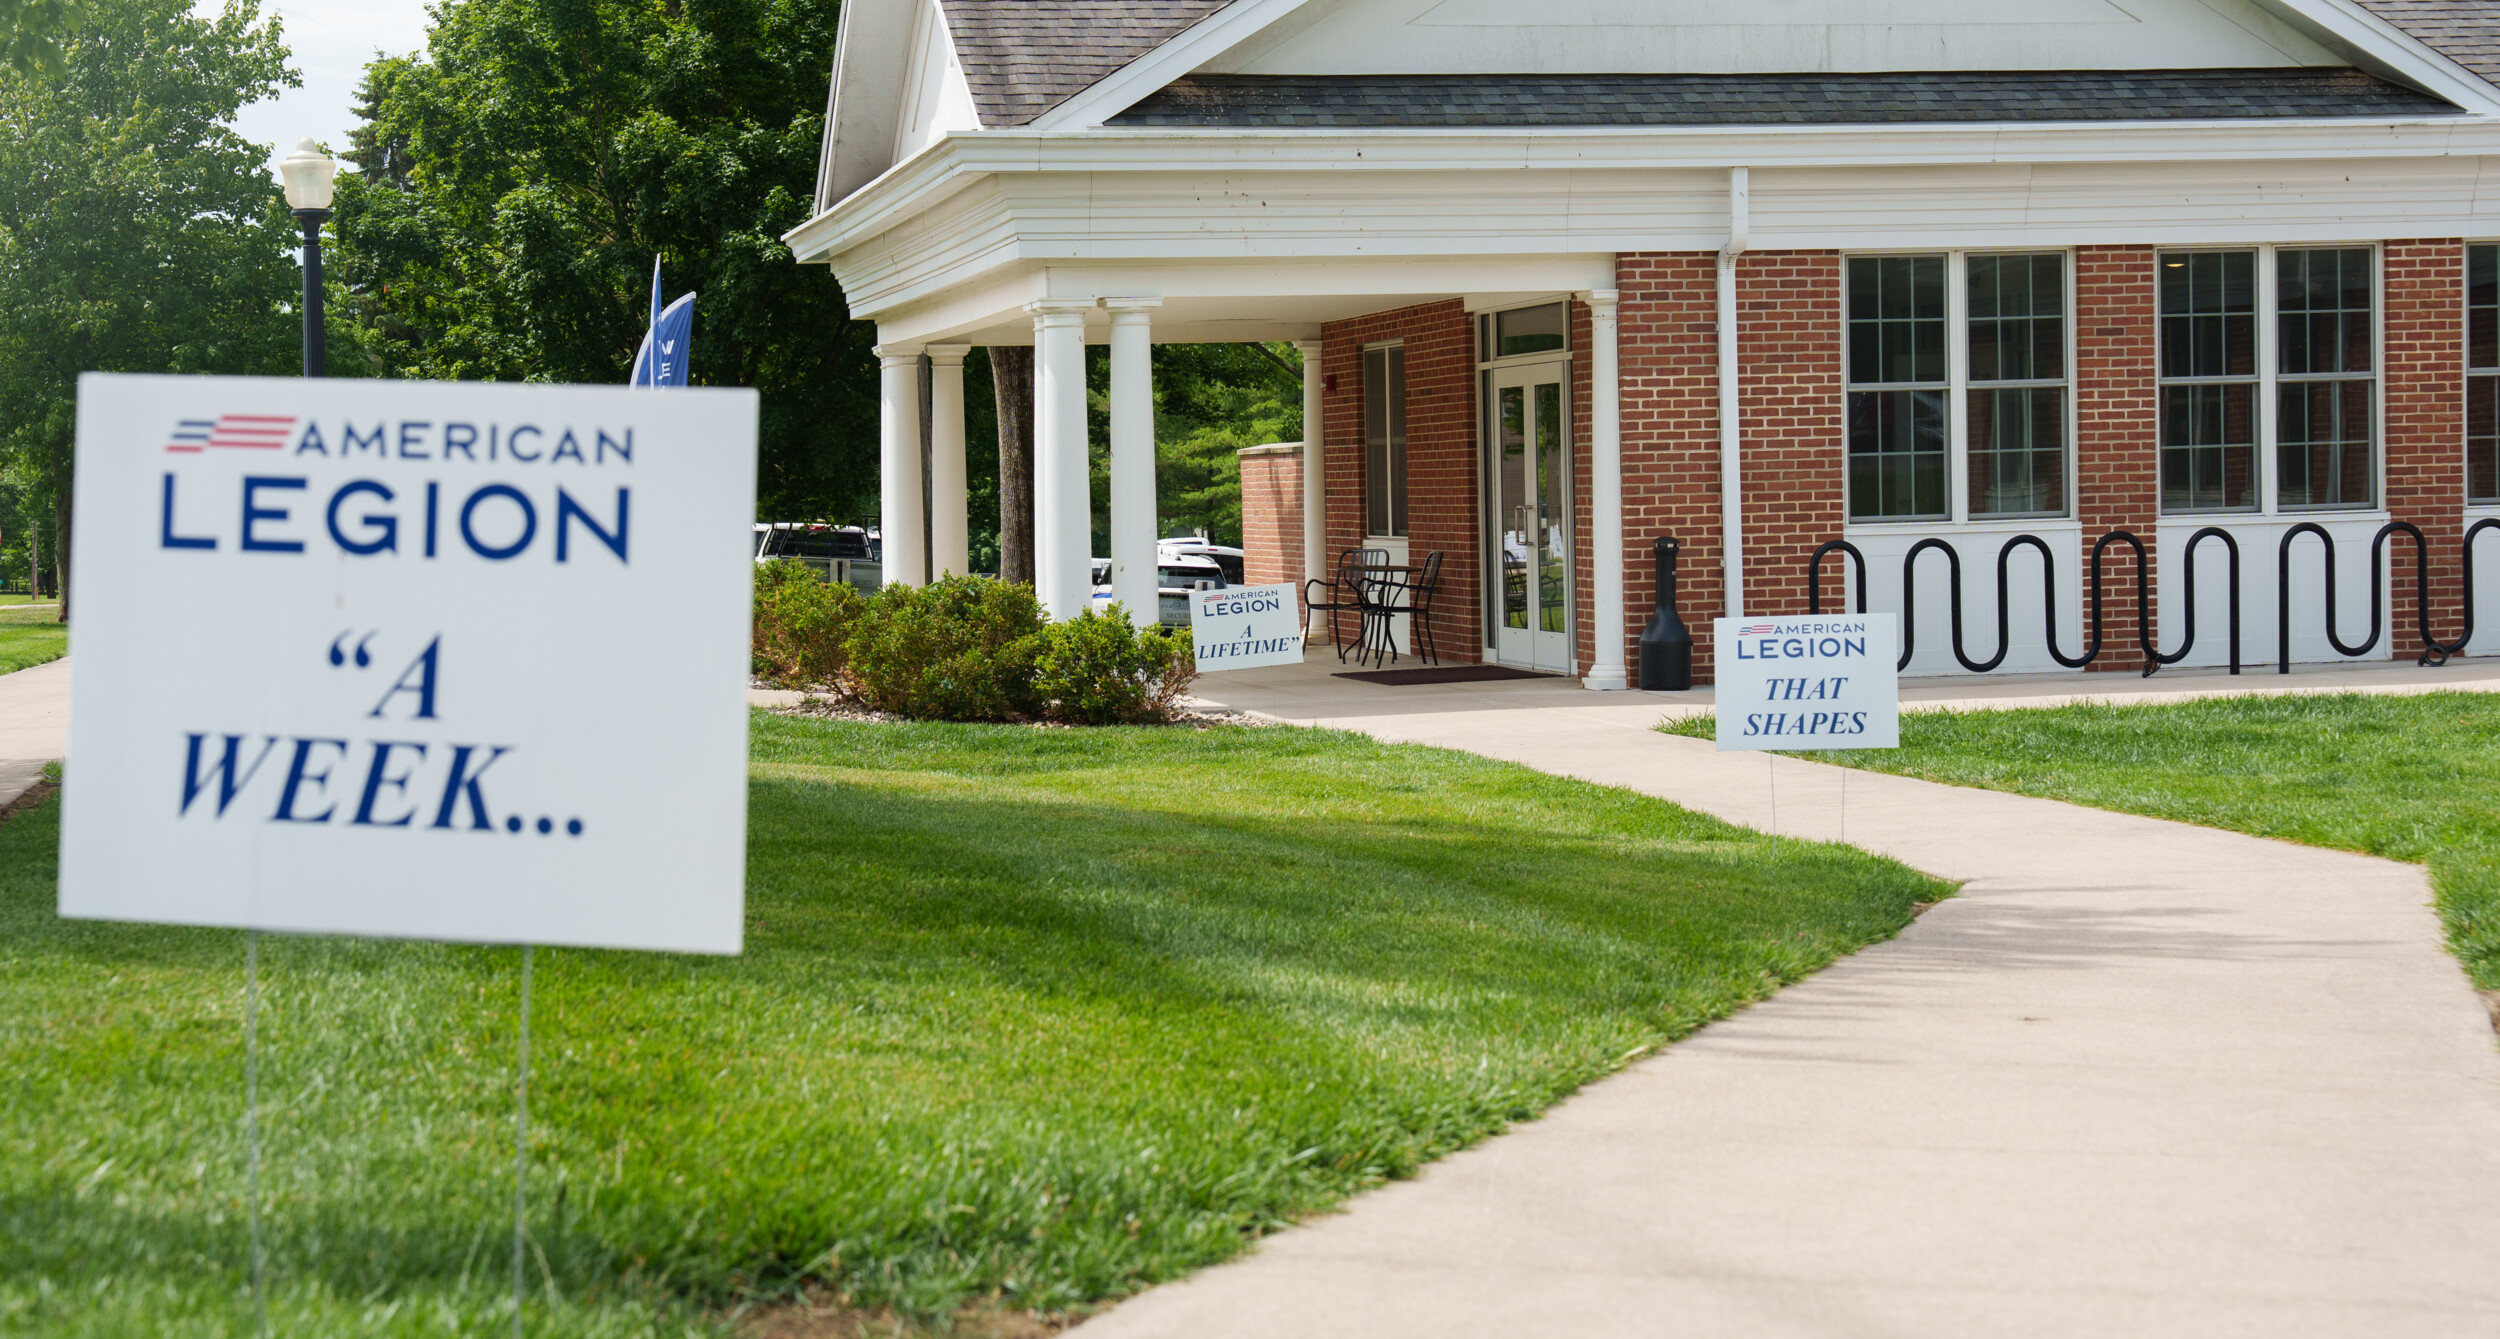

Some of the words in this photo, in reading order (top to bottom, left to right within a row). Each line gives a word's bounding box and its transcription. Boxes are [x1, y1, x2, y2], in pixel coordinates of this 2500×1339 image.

[296, 420, 634, 465] AMERICAN
[159, 472, 631, 565] LEGION
[1224, 589, 1278, 601] AMERICAN
[1203, 598, 1280, 617] LEGION
[1240, 624, 1252, 638] A
[1774, 623, 1865, 635] AMERICAN
[1738, 637, 1866, 659] LEGION
[1766, 677, 1848, 700] THAT
[1744, 711, 1867, 736] SHAPES
[178, 731, 586, 838] WEEK...
